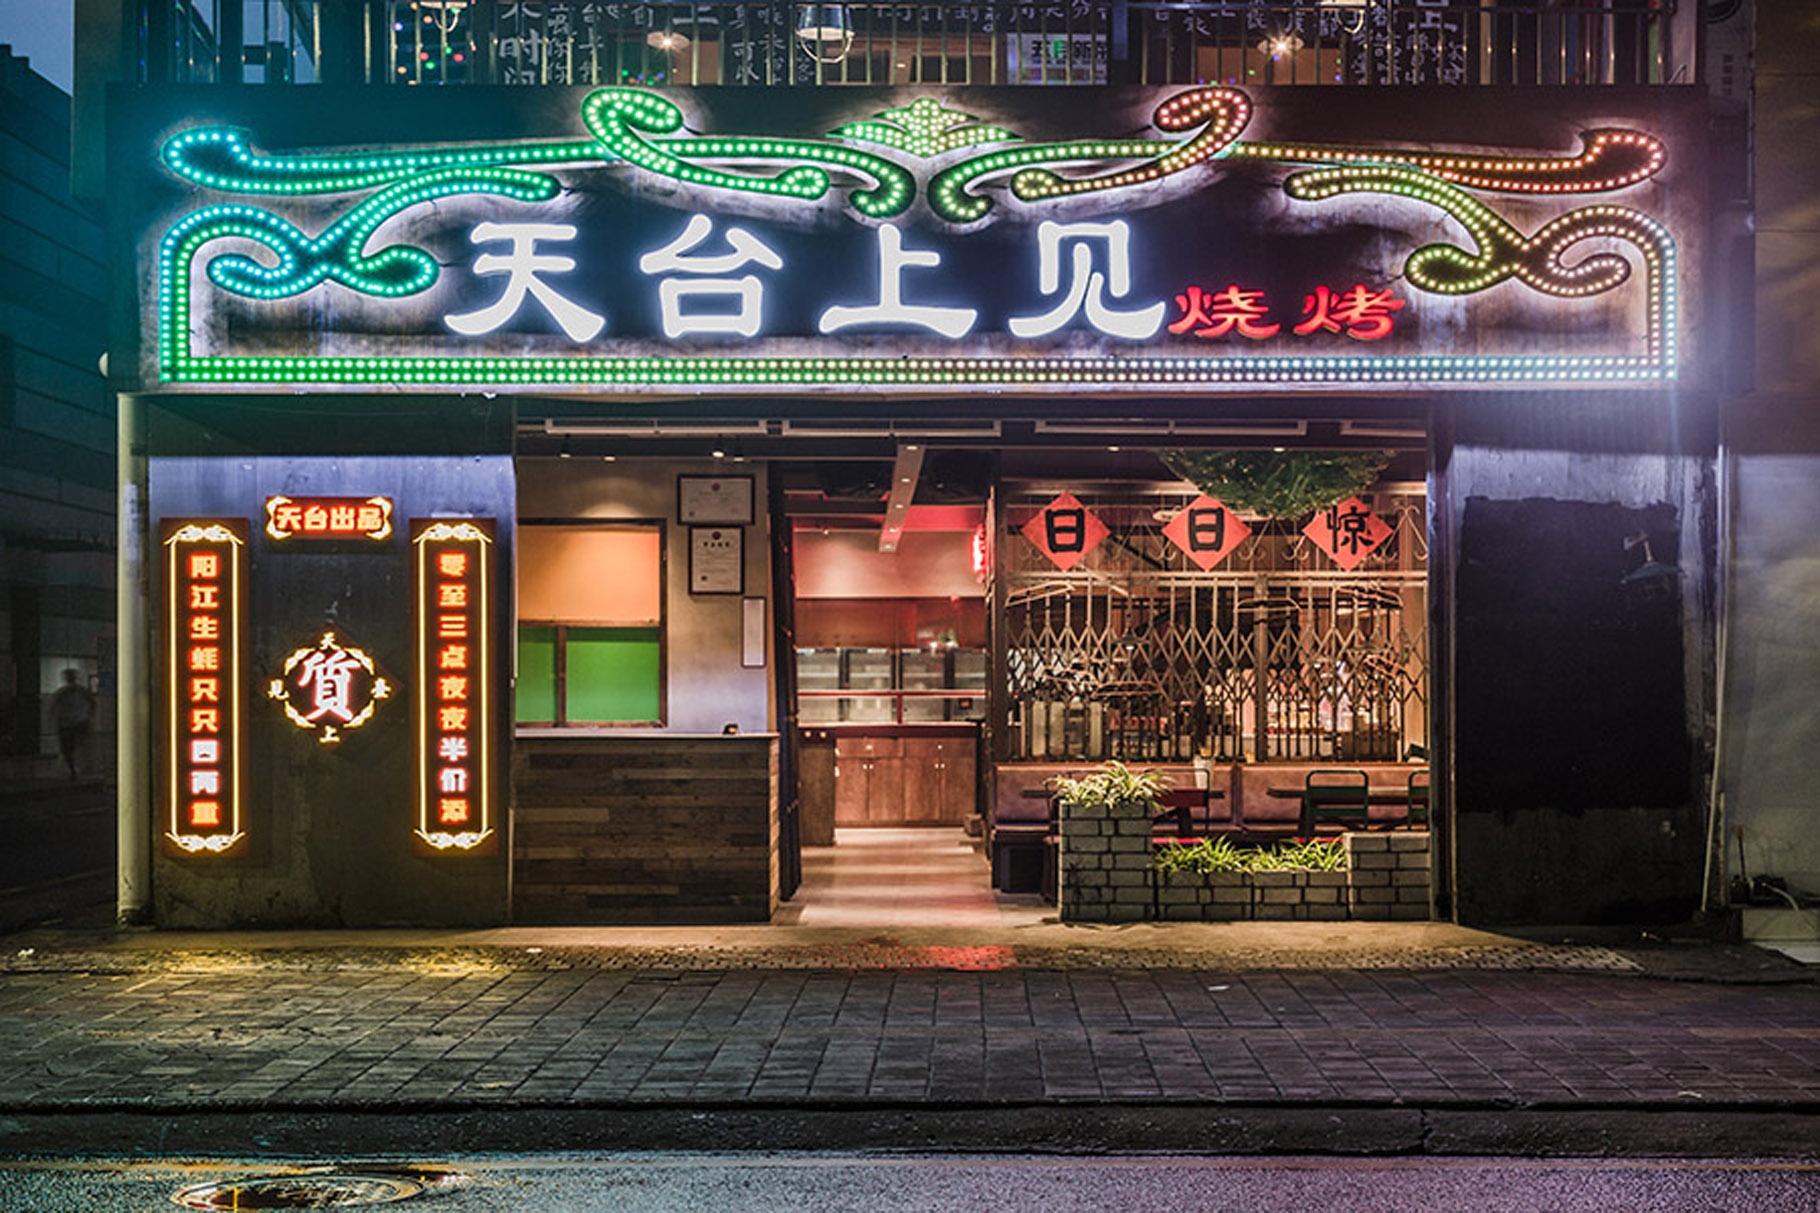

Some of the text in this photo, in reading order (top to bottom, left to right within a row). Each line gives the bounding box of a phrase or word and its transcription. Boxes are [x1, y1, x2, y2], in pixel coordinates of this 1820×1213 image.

[444, 214, 1406, 343] 天台上见 烧烤
[276, 504, 382, 531] 天台出品
[1045, 508, 1086, 553] 日
[1188, 507, 1225, 552] 日
